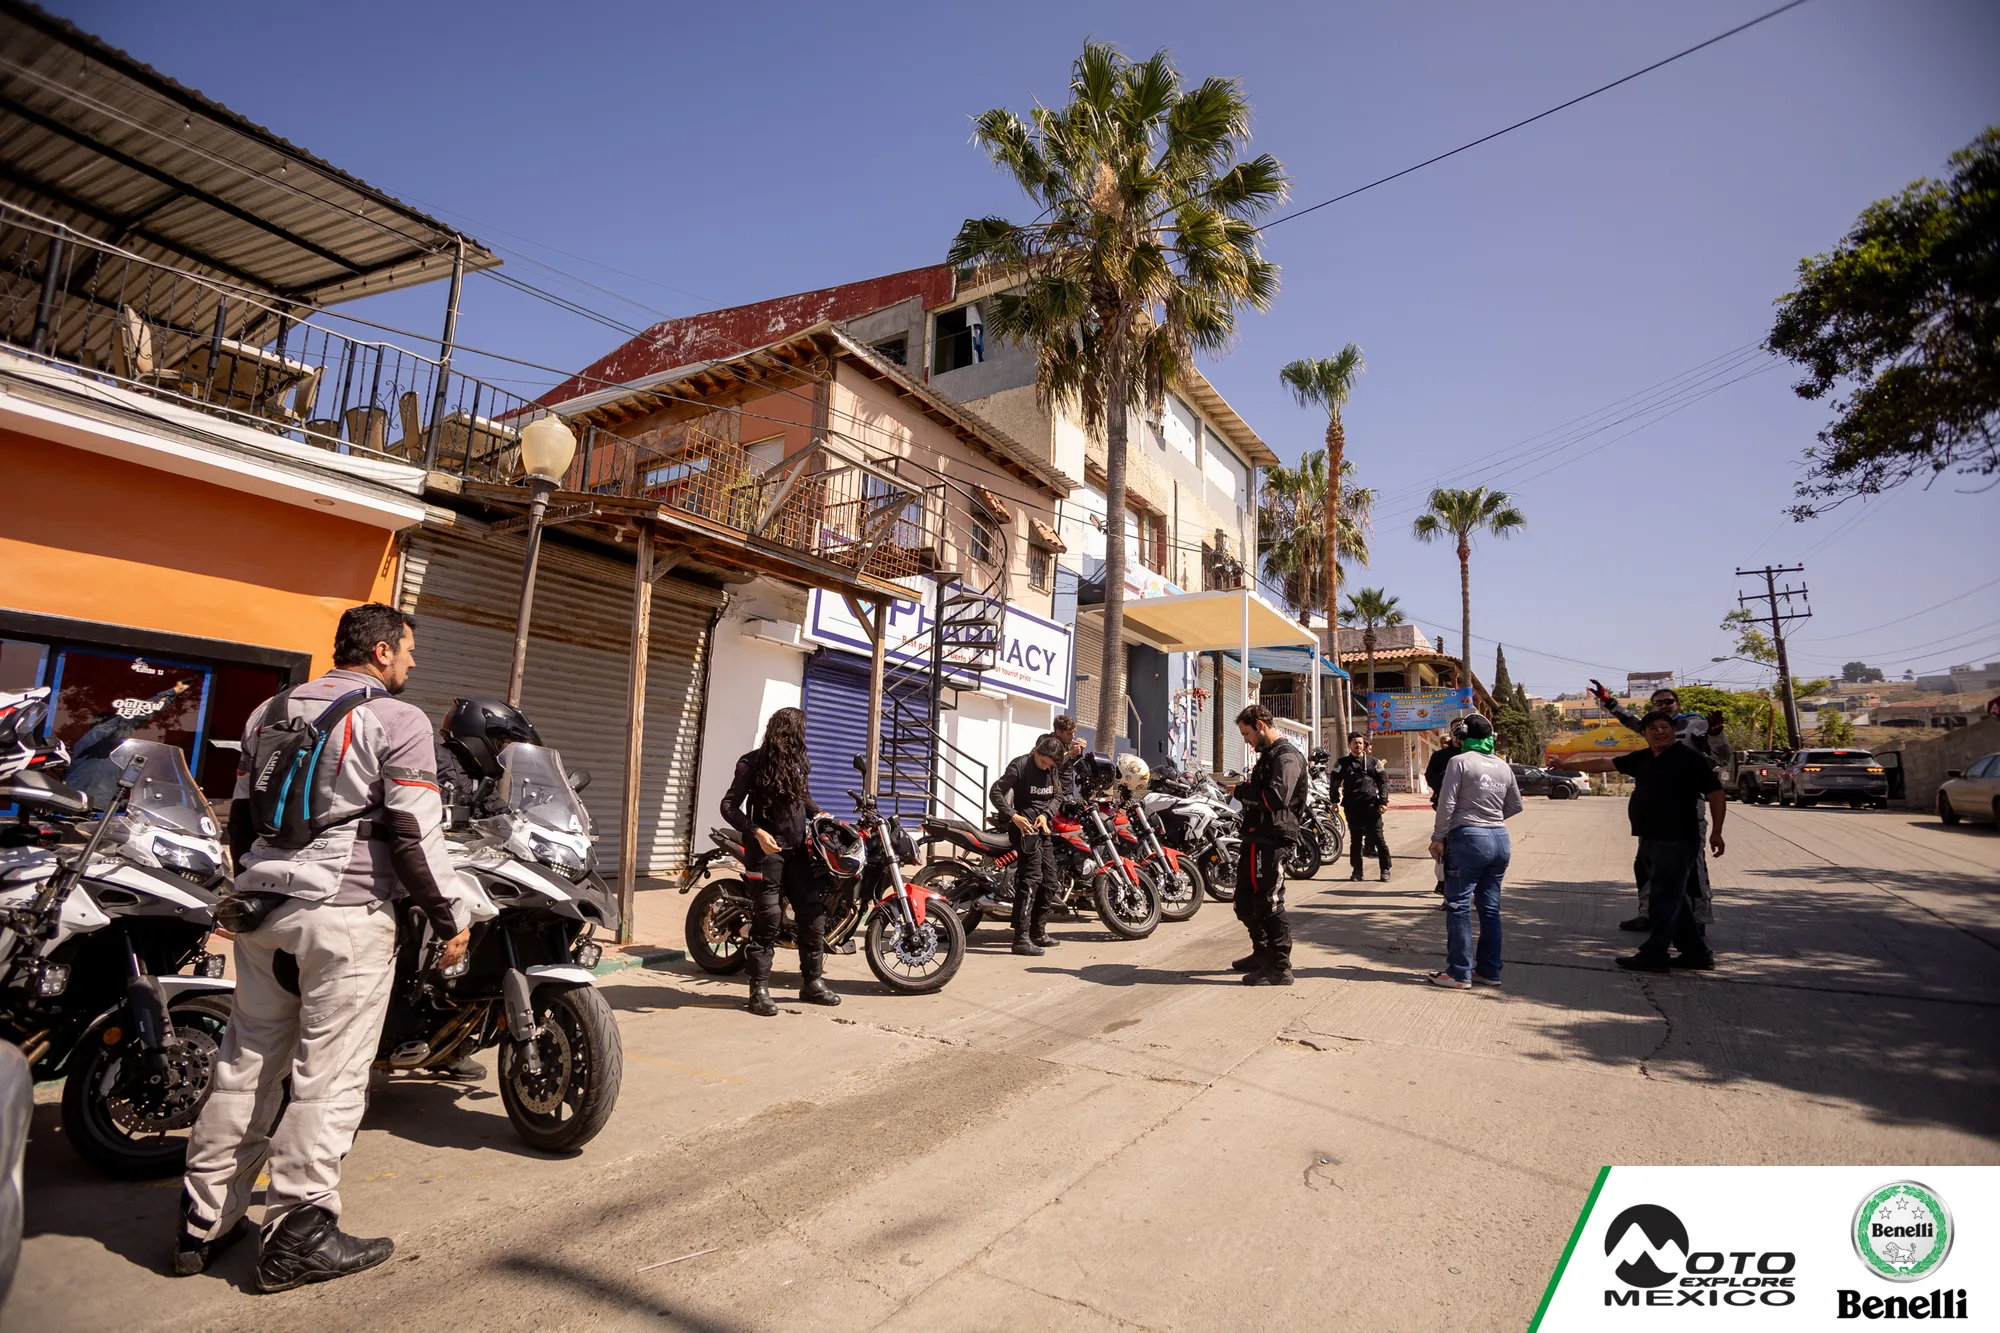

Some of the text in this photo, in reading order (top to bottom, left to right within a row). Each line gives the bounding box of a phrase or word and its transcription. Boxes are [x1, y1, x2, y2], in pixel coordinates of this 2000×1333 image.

[1001, 667, 1019, 678] tourist
[1018, 672, 1032, 682] price
[253, 750, 282, 793] CAMELBAK
[1030, 785, 1054, 795] Benell
